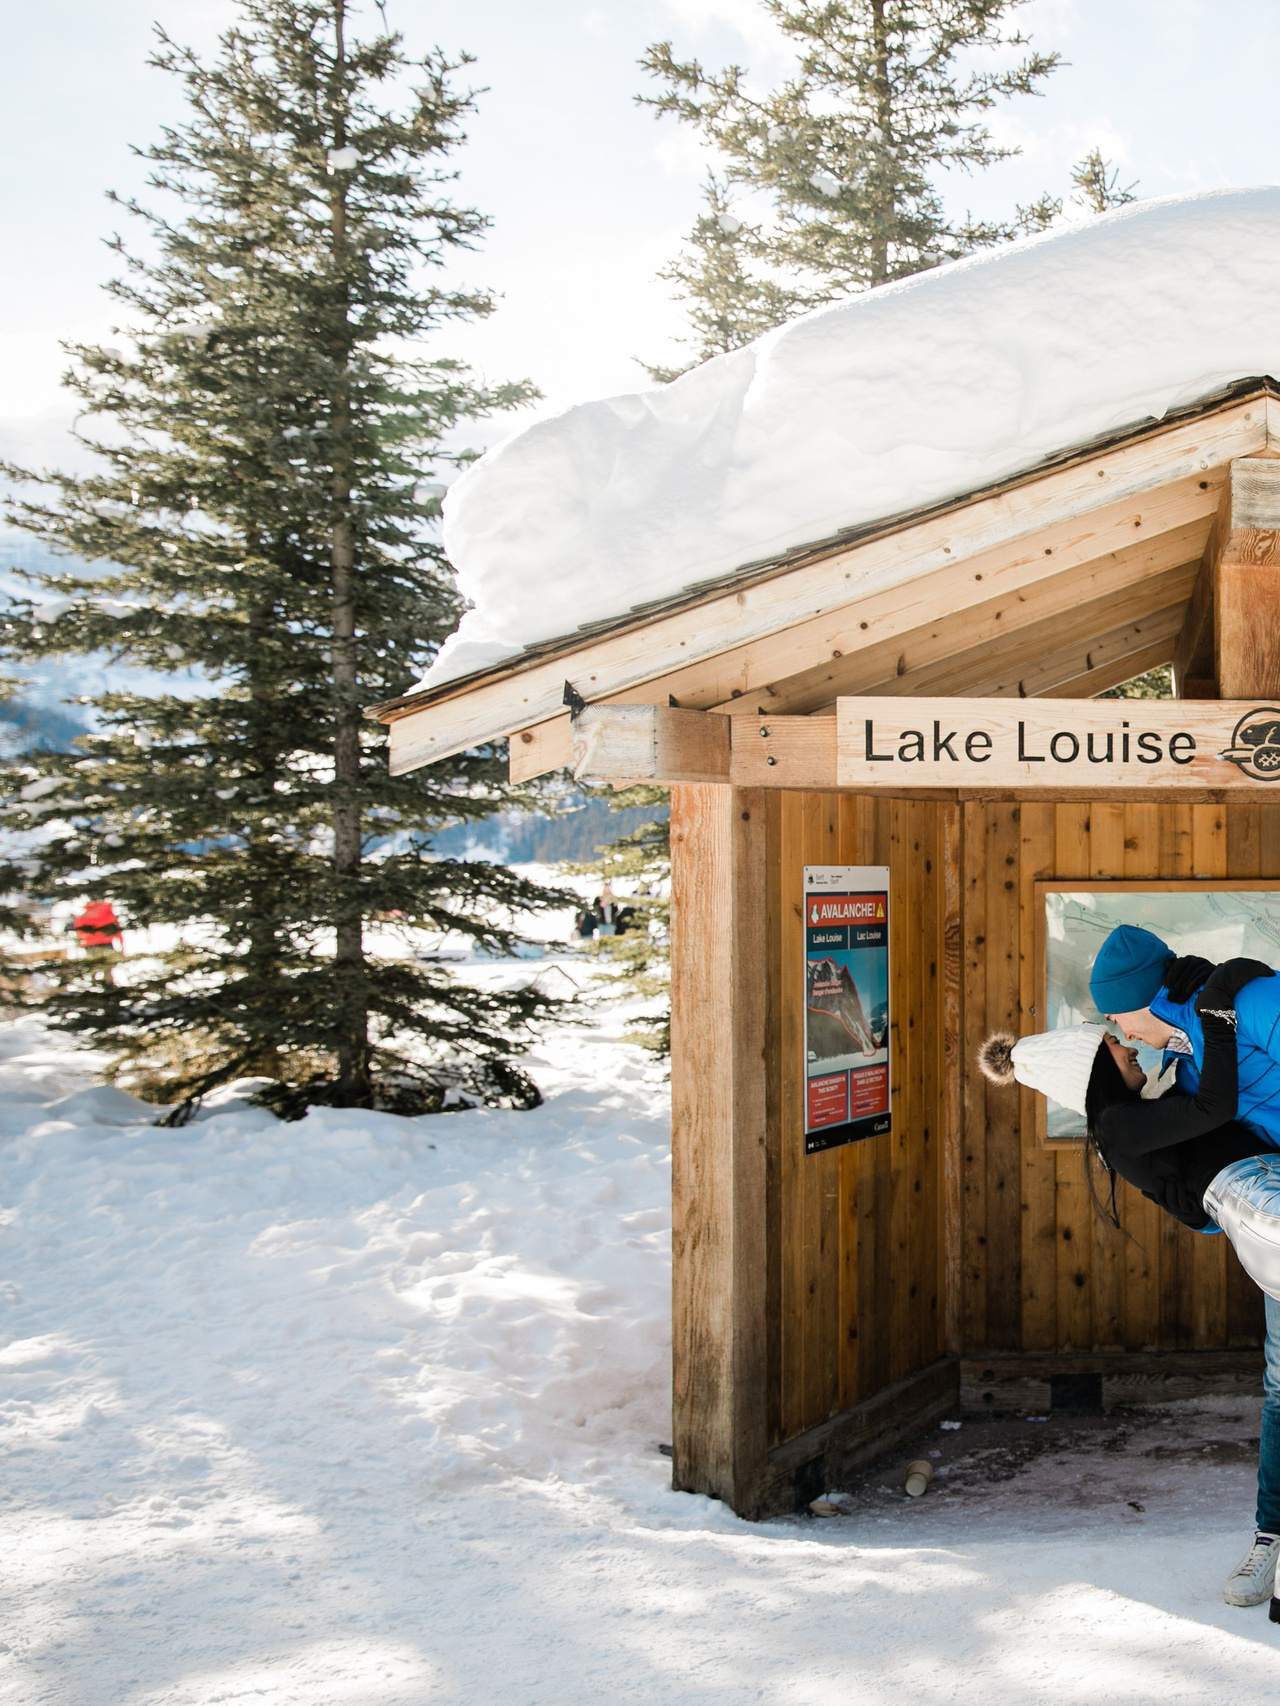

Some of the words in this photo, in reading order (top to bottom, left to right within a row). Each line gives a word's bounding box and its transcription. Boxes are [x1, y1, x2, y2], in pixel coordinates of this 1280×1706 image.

[865, 719, 993, 762] Lake
[1017, 720, 1197, 765] Louise
[821, 903, 876, 919] AVALANCHE!
[813, 934, 825, 944] Lake
[827, 933, 843, 943] Louise
[857, 932, 866, 941] Lac
[867, 931, 882, 940] Louise
